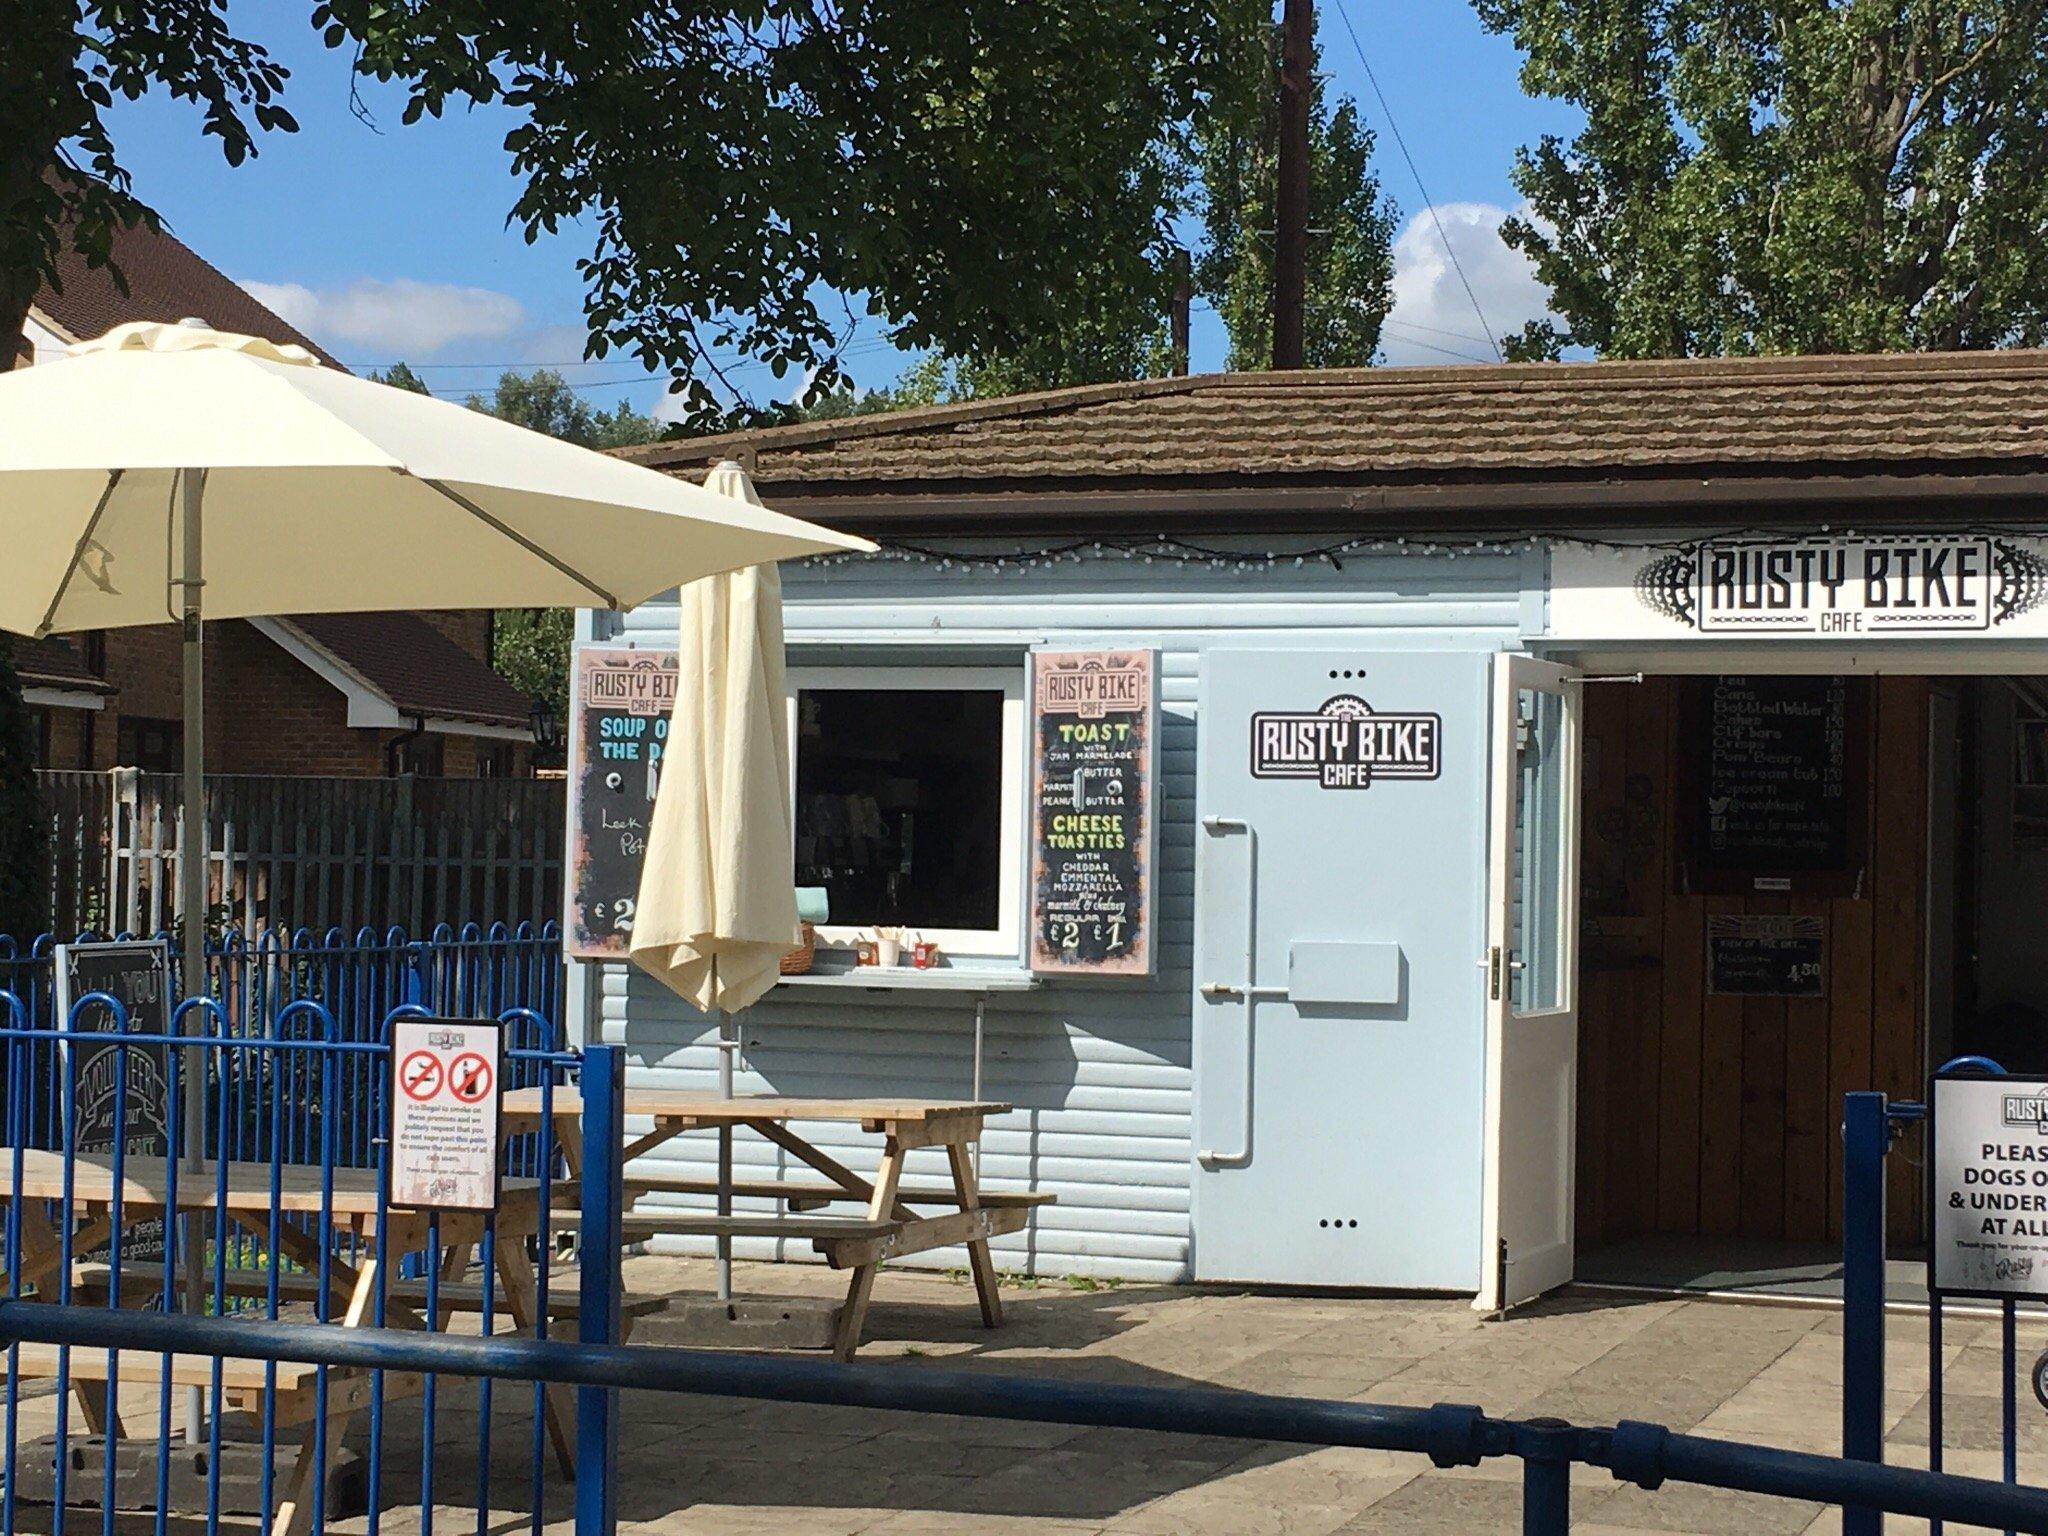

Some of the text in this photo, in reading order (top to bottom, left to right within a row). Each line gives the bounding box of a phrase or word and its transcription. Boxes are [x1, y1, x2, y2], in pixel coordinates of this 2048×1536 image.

[1711, 547, 1977, 609] RUSTY BIKE
[1821, 612, 1862, 632] CAFE
[594, 673, 679, 698] RUSTY BI
[1050, 675, 1135, 700] RUSTY BIKE
[631, 700, 657, 712] CAFE
[1081, 702, 1103, 716] CAFE
[600, 717, 669, 739] SOUP O
[1059, 723, 1130, 743] TOAST
[1262, 721, 1429, 761] RUSTY BIKE
[599, 742, 664, 761] THE D
[1050, 752, 1070, 761] JAM
[1084, 767, 1123, 777] BUTTER
[1323, 763, 1367, 786] CAFE
[1043, 783, 1074, 792] MARMIT
[1085, 797, 1125, 806] BUTTER
[1053, 815, 1123, 832] CHEESE
[1047, 834, 1125, 849] TOASTIES
[1076, 852, 1100, 860] WITH
[1063, 862, 1109, 872] CHEDDAR
[1061, 873, 1119, 883] EMMENTAL
[1053, 883, 1123, 892] MOZZARELLA
[1050, 914, 1100, 923] REGULAR
[122, 971, 158, 1004] YOU
[1964, 1167, 2026, 1187] DOGS
[1948, 1191, 2047, 1212] & UNDER
[1981, 1217, 2007, 1236] AT
